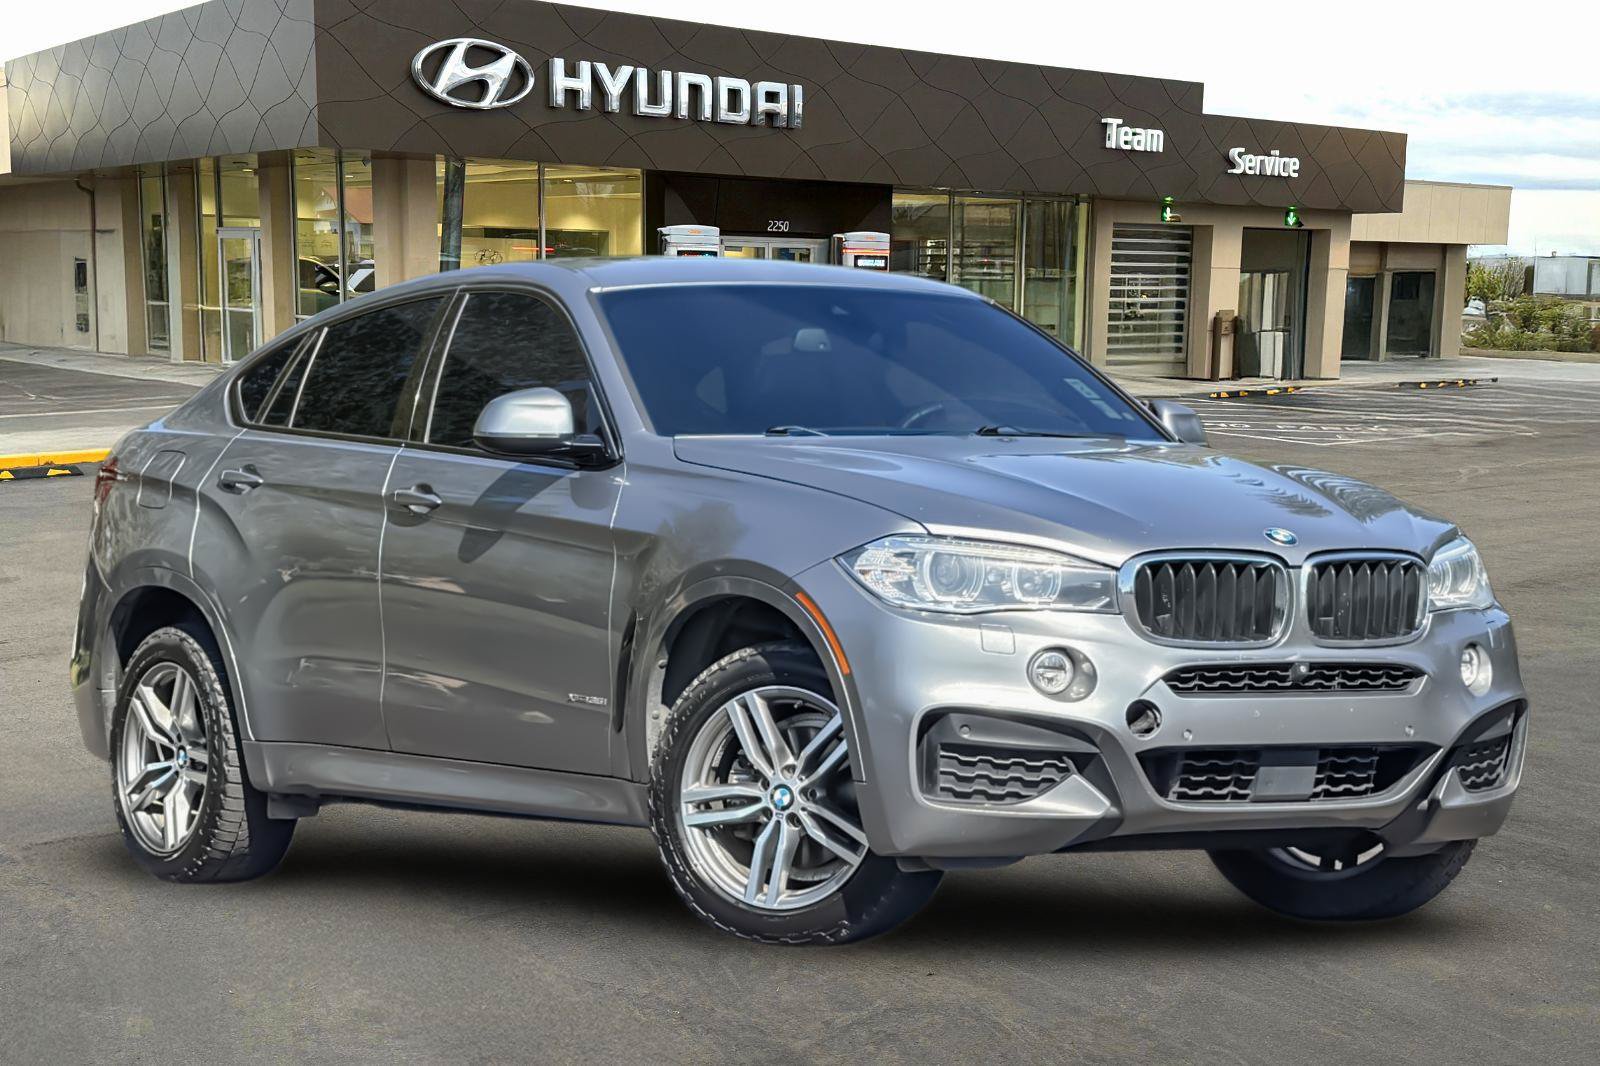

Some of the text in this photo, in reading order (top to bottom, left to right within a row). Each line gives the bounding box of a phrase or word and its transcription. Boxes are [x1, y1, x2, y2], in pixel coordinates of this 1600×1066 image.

[549, 57, 803, 128] HYUNDAI
[1101, 117, 1164, 153] Team
[1227, 147, 1300, 178] Service
[767, 220, 790, 232] 2250
